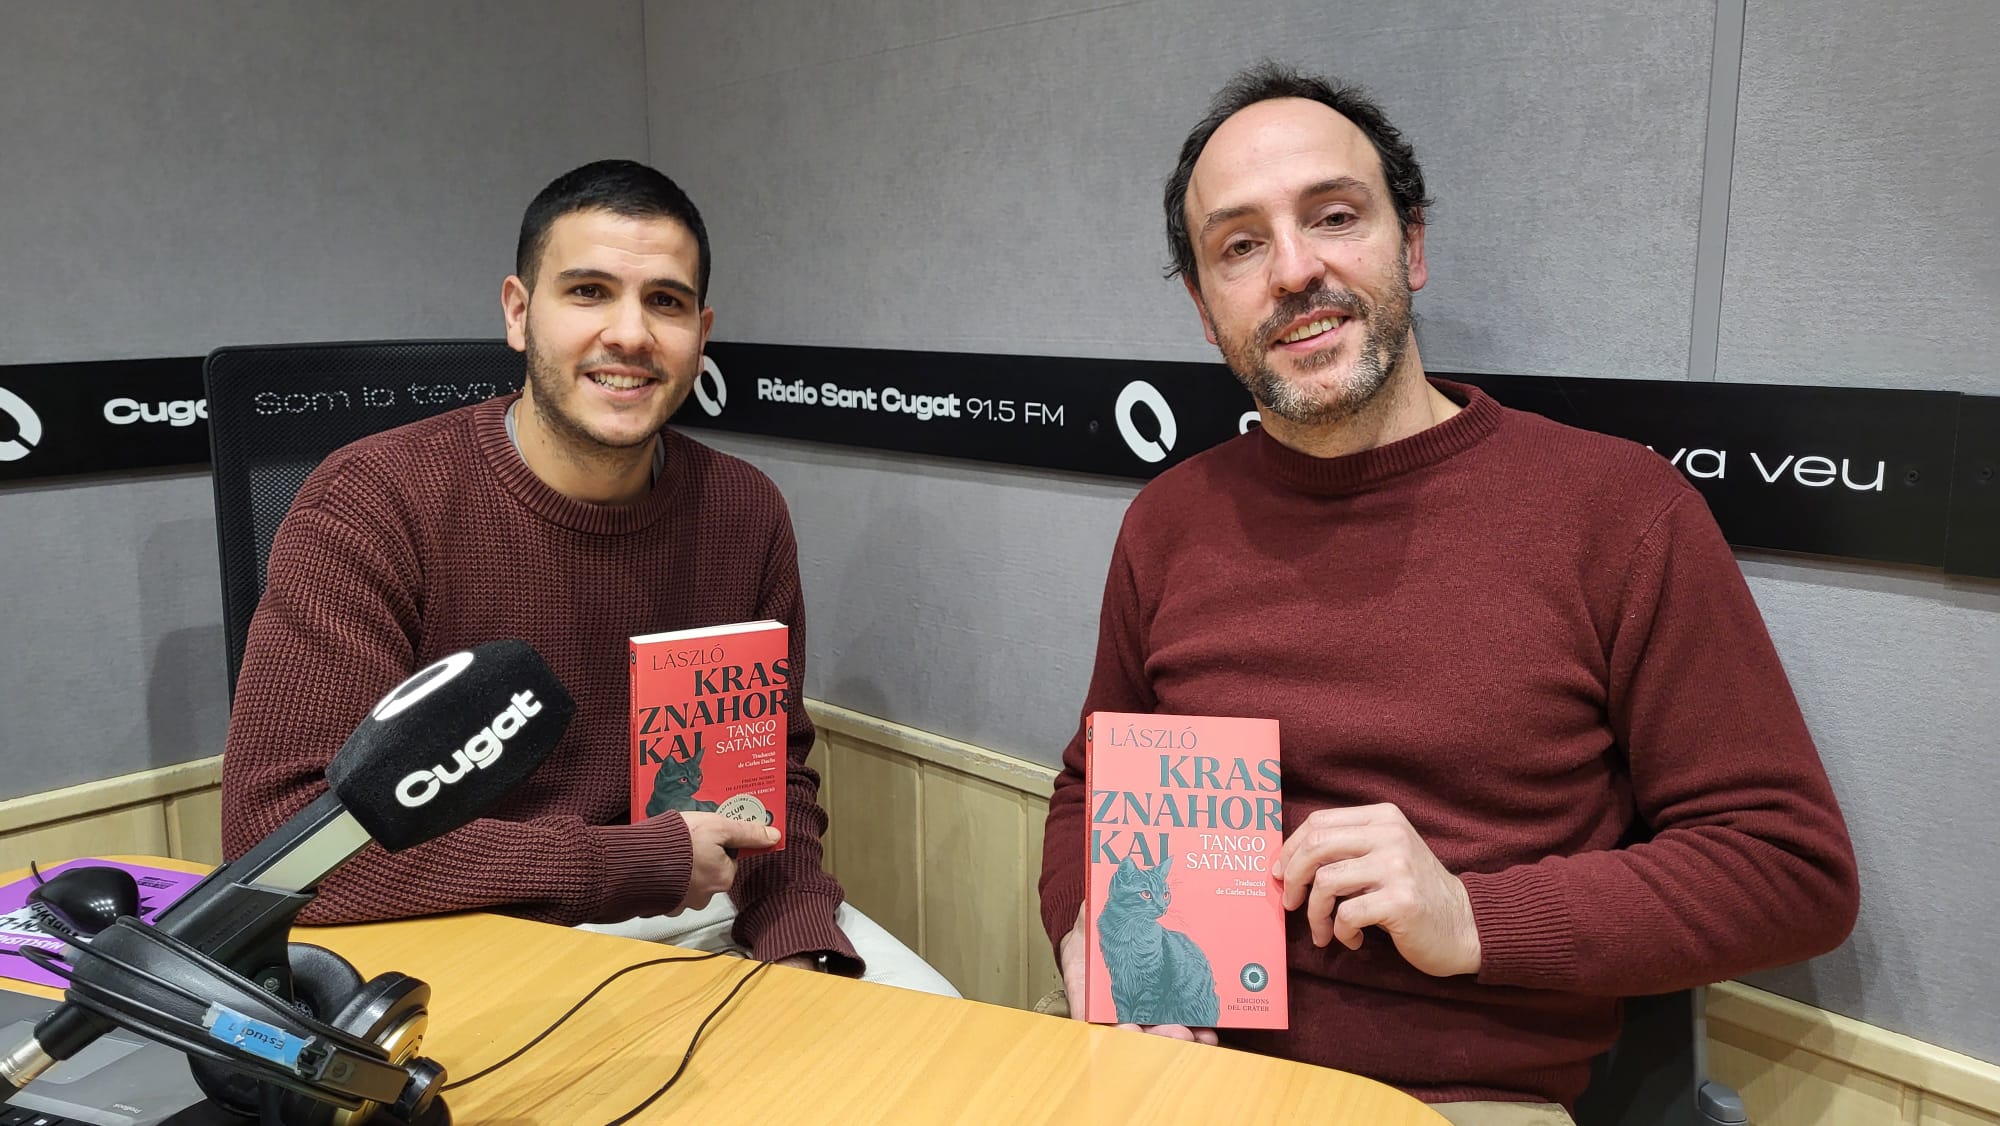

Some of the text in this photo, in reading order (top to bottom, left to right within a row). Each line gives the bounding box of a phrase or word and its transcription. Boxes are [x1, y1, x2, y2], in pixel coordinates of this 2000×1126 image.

[407, 382, 498, 404] teva
[757, 377, 1065, 427] Ràdio Sant Cugat 91.5 FM
[1750, 452, 1885, 492] veu
[653, 644, 724, 671] LÁSZLÓ
[695, 658, 790, 697] KRAS
[639, 689, 790, 735] ZNAHOR
[726, 720, 777, 738] TANGO
[1110, 724, 1198, 750] LÁSZLÓ
[395, 689, 543, 807] Cugat
[1159, 754, 1281, 792] KRAS
[725, 804, 745, 818] CLUB
[1092, 790, 1283, 832] ZNAHOR
[1091, 830, 1170, 866] KAI
[1199, 834, 1267, 852] TANGO
[1186, 850, 1267, 872] SATÀNIC
[1225, 888, 1246, 896] Carles
[1236, 997, 1270, 1005] EDICIONS
